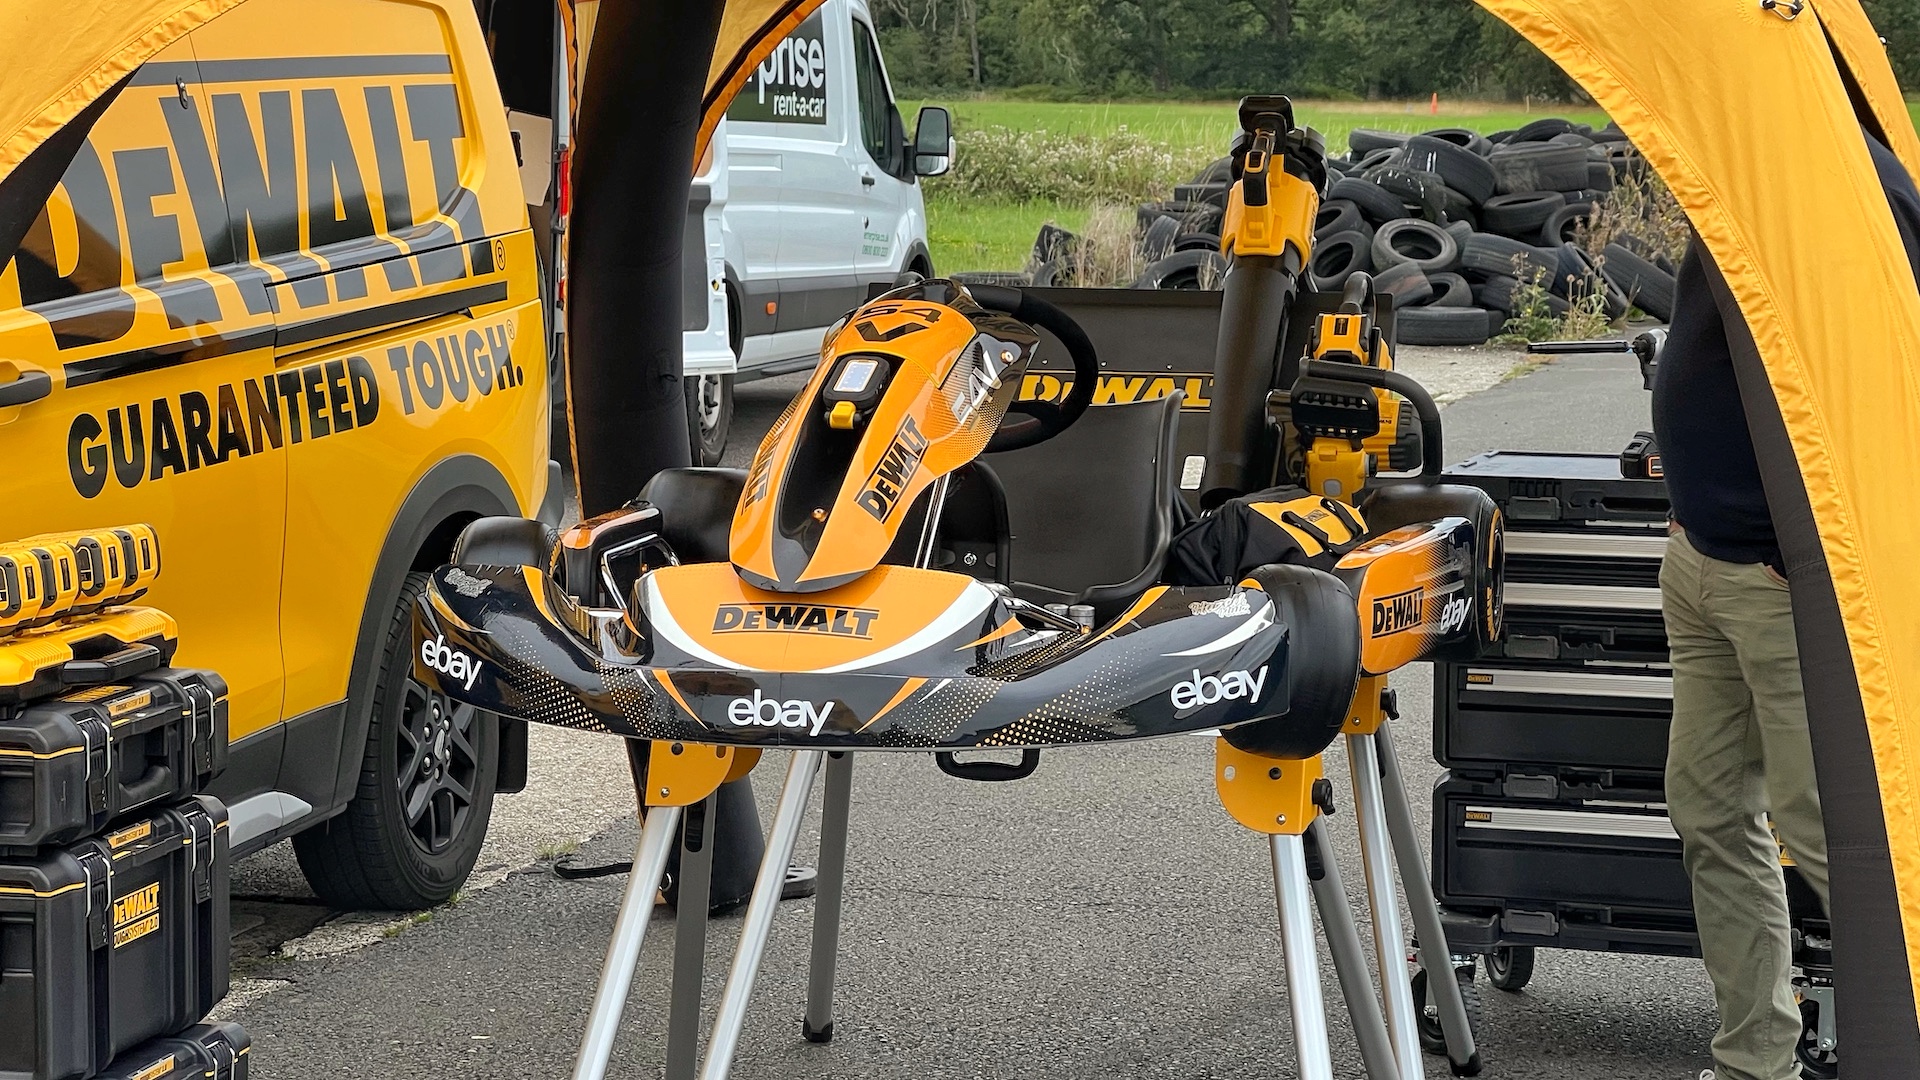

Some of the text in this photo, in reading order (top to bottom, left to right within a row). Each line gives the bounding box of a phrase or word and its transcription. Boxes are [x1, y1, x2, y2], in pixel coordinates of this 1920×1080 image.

[747, 37, 825, 104] prise
[773, 91, 825, 117] rent-a-car
[1019, 375, 1214, 408] DWAL
[67, 355, 380, 499] GUARANTEED
[857, 415, 929, 522] DEWALT
[712, 605, 879, 636] DEWALT
[1371, 591, 1425, 634] DEWALT
[1439, 592, 1473, 632] ebay
[421, 634, 483, 692] ebay
[1170, 664, 1269, 710] ebay
[727, 688, 836, 737] ebay
